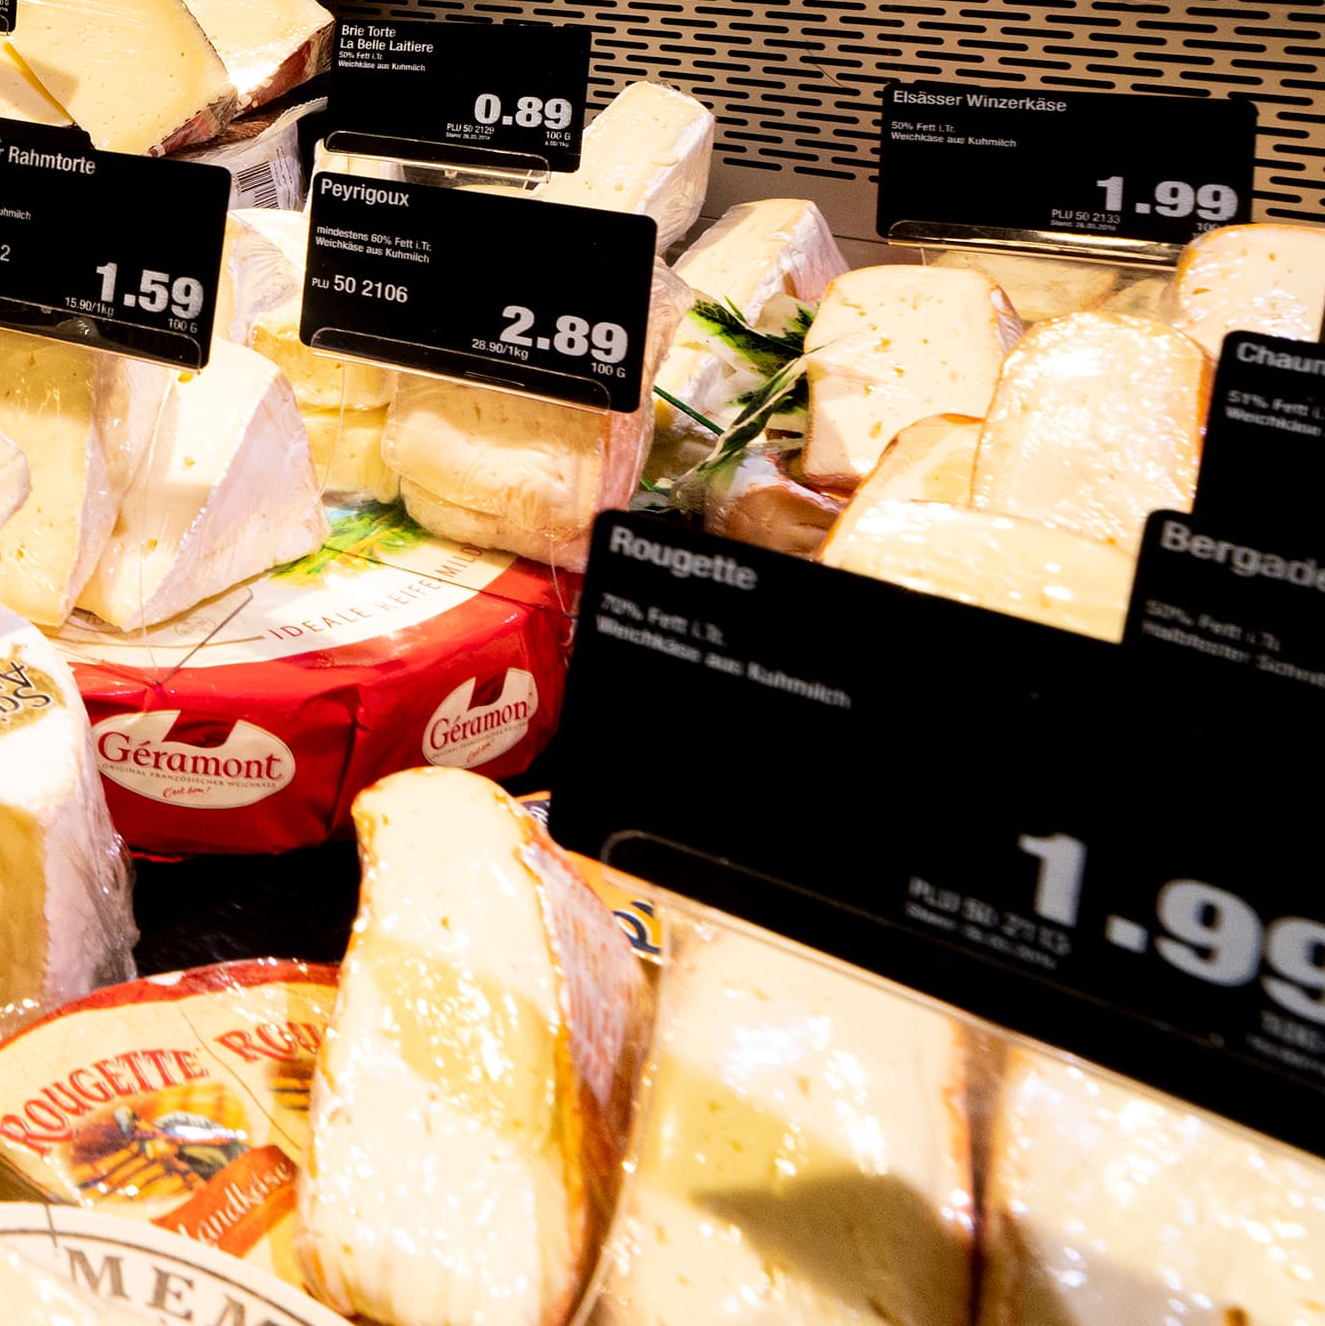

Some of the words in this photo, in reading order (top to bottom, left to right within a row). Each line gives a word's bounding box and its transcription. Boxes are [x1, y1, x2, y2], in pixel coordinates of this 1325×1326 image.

[340, 38, 354, 49] La
[357, 39, 386, 51] Belle
[389, 40, 434, 53] Laitiere
[341, 25, 364, 37] Brie
[367, 26, 396, 38] Torte
[474, 93, 573, 130] 0.89
[893, 90, 962, 107] Elsässer
[966, 94, 1067, 112] Winzerkäse
[891, 131, 945, 143] Weichkäse
[947, 135, 965, 145] aus
[968, 136, 1017, 148] Kuhmilch
[8, 146, 96, 175] Rahmtorte
[320, 178, 410, 207] Peyrigoux
[1097, 175, 1239, 222] 1.99
[1052, 209, 1073, 220] PLU
[1075, 211, 1090, 222] 50
[1092, 212, 1122, 225] 2133
[315, 236, 364, 252] Weichkäse
[366, 244, 383, 256] aus
[385, 248, 430, 264] Kuhmilch
[316, 226, 369, 242] mindestens
[370, 233, 392, 246] 60%
[394, 236, 414, 249] Fett
[96, 262, 204, 319] 1.59
[312, 277, 330, 289] PLU
[333, 275, 356, 294] 50
[361, 280, 408, 303] 2106
[65, 297, 114, 317] 15.90/1kg
[499, 305, 629, 364] 2.89
[471, 338, 529, 361] 28.90/1kg
[591, 362, 613, 376] 100
[616, 366, 626, 379] G
[609, 525, 758, 591] Rougette
[268, 606, 373, 640] IDEALE
[436, 545, 483, 578] MILD
[430, 700, 532, 750] Géramon
[98, 731, 283, 781] Géramont
[1018, 831, 1325, 1026] 1.99
